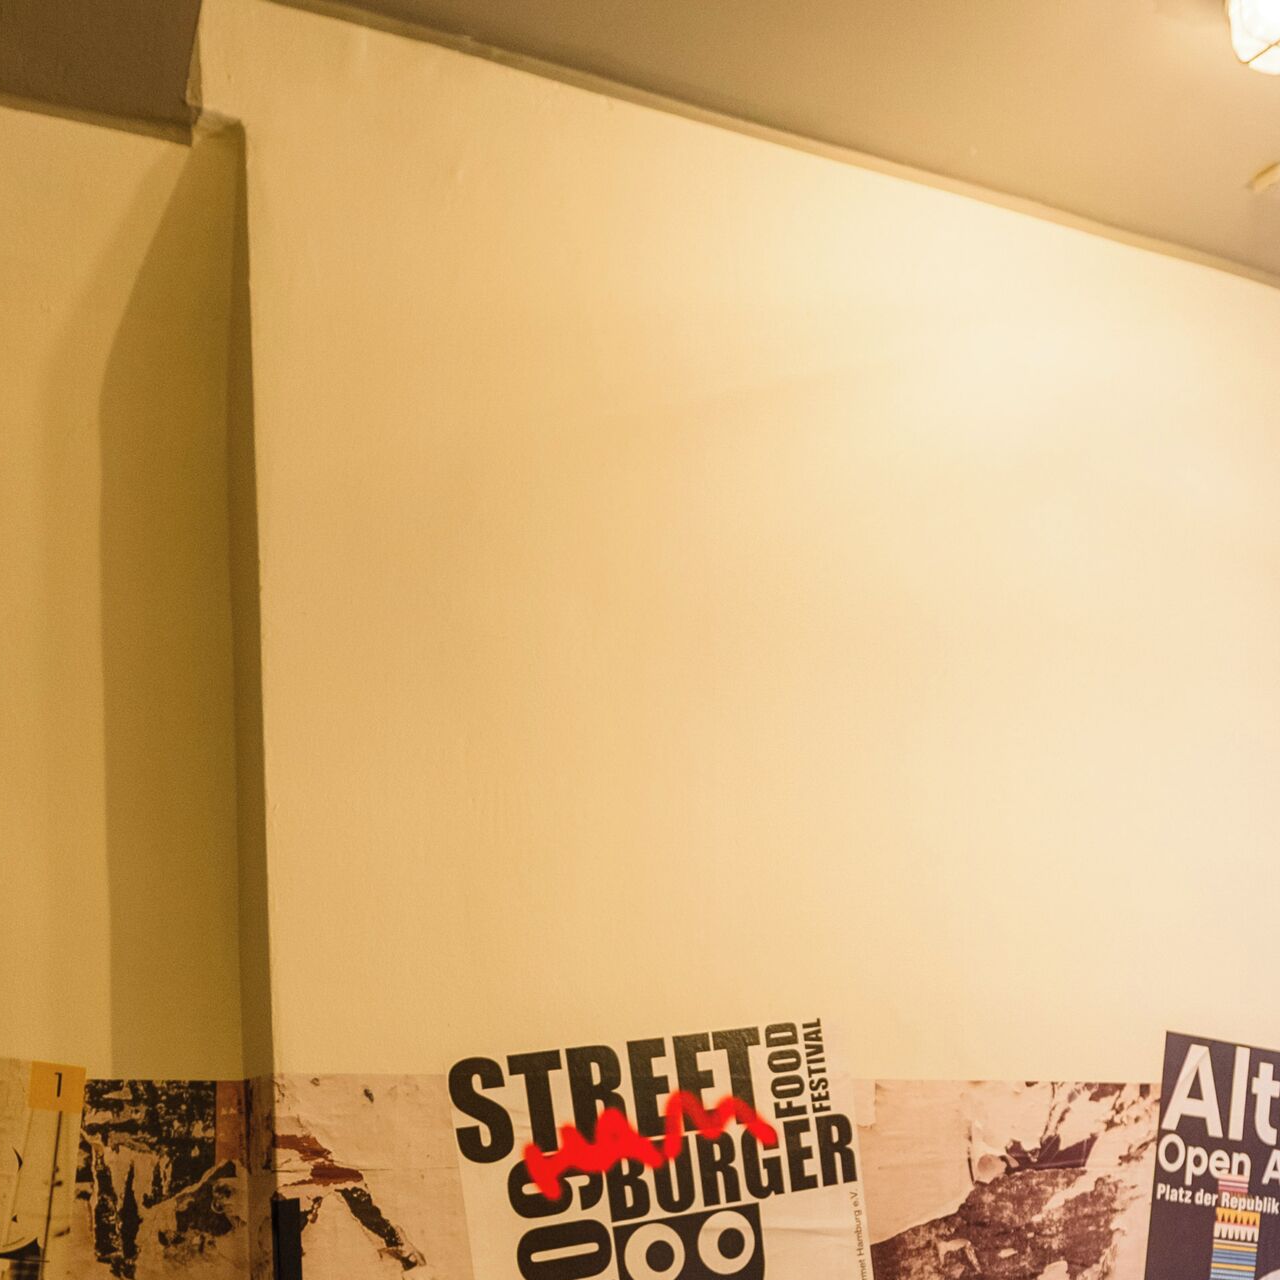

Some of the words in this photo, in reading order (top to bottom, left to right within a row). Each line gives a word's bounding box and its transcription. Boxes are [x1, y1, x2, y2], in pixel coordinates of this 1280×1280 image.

[447, 1025, 761, 1164] STREET
[764, 1021, 808, 1119] FOOD
[802, 1016, 832, 1114] FESTIVAL
[605, 1112, 858, 1222] BURGER
[1156, 1183, 1192, 1205] Platz
[1195, 1189, 1218, 1208] der
[1221, 1191, 1280, 1216] Republik
[1157, 1133, 1252, 1186] Open
[852, 1207, 866, 1257] Hamburg
